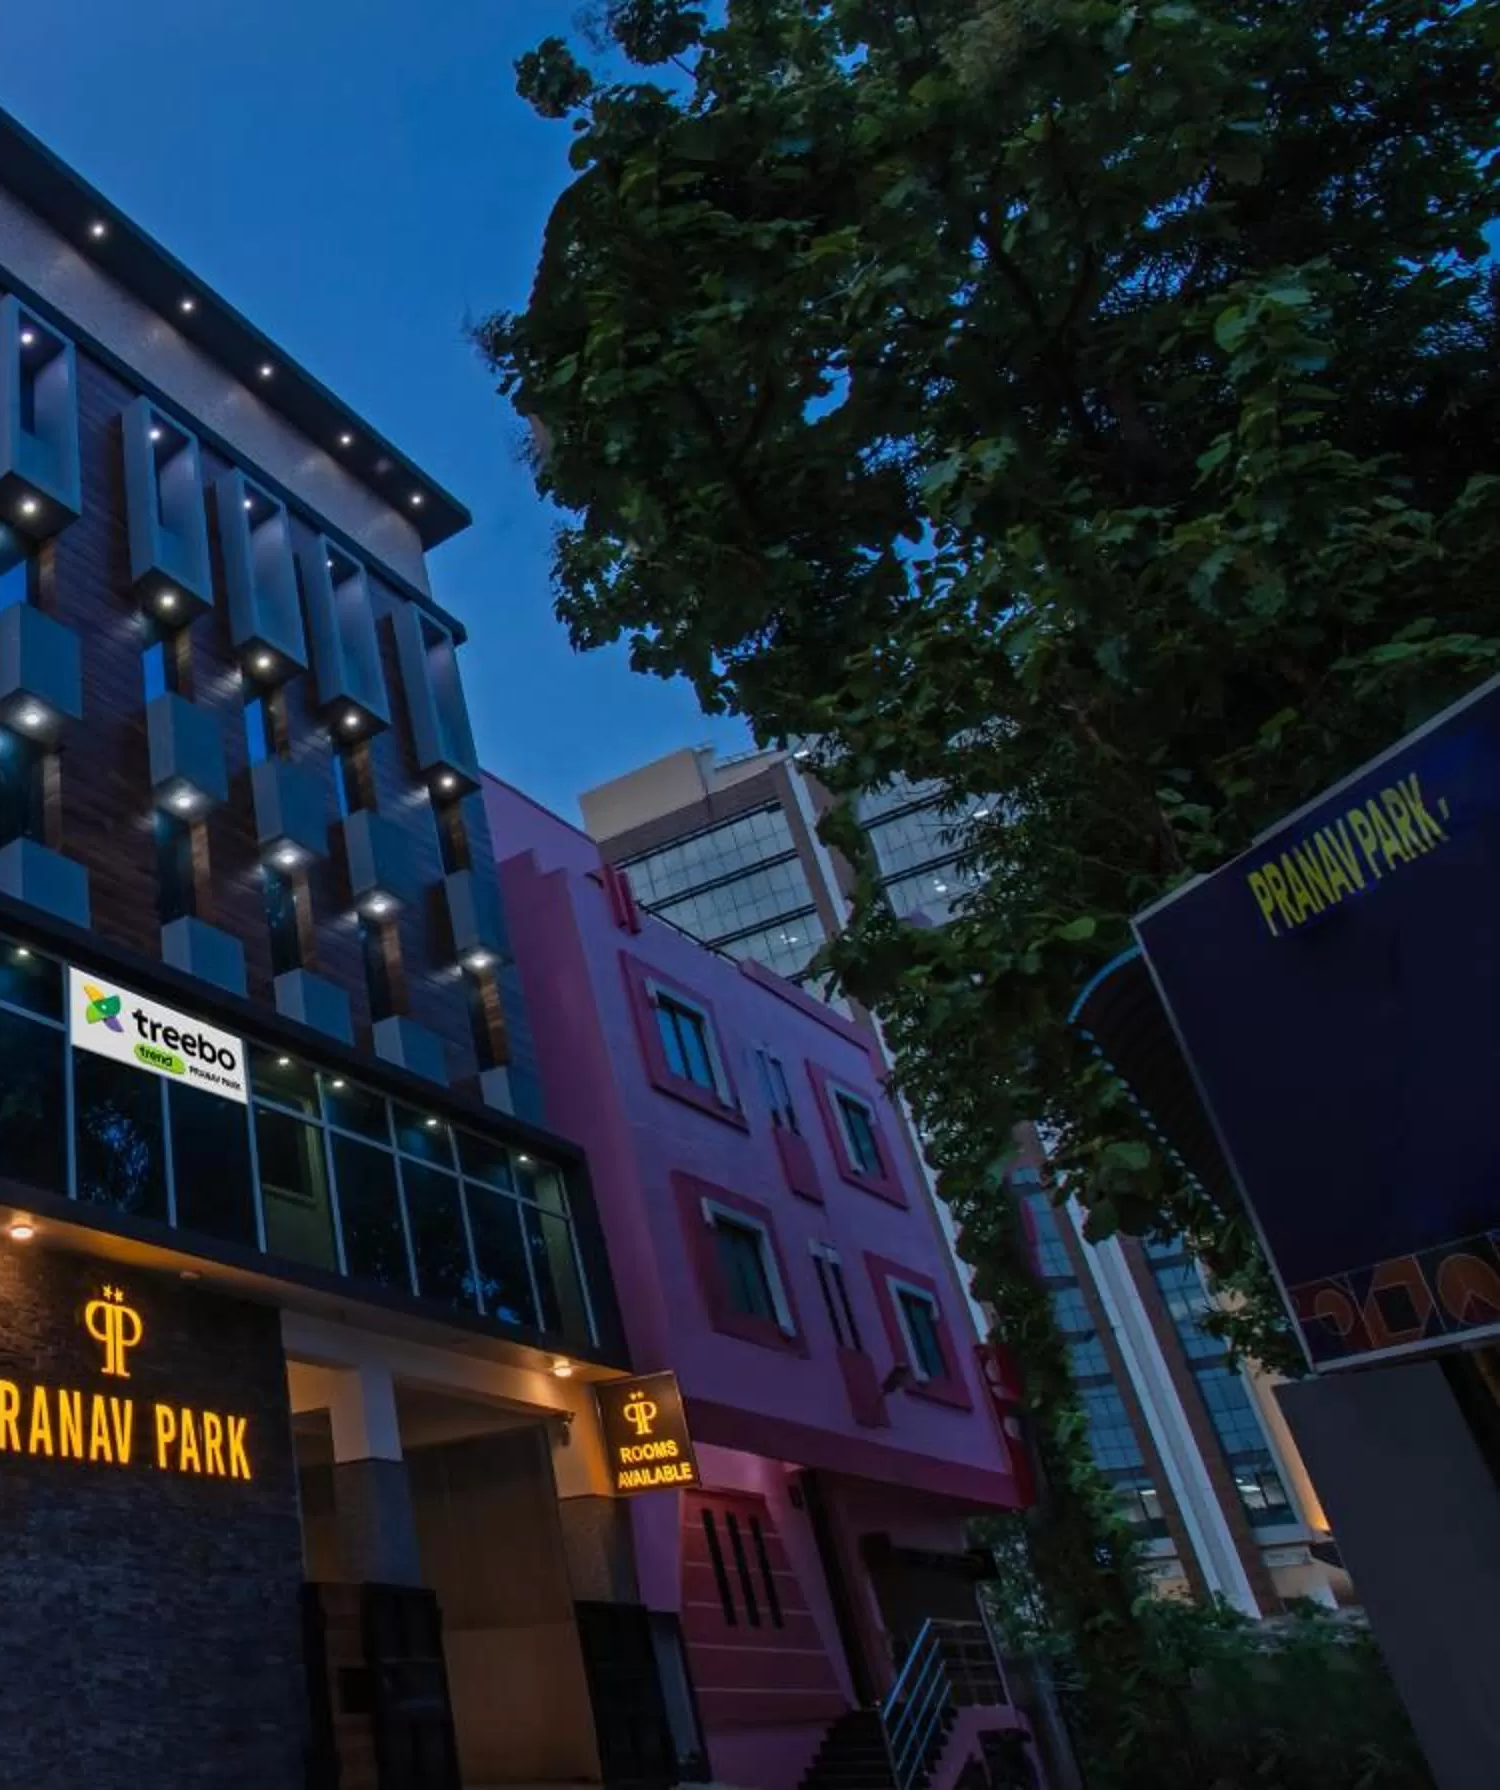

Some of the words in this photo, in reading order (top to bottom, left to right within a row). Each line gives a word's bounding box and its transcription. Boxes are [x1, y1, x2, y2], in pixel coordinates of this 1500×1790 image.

[1247, 819, 1365, 937] PRANAV
[132, 1008, 236, 1071] treebo
[139, 1045, 173, 1067] trend
[155, 1404, 251, 1480] PARK
[620, 1440, 678, 1464] ROOMS
[618, 1461, 693, 1489] AVAILABLE
